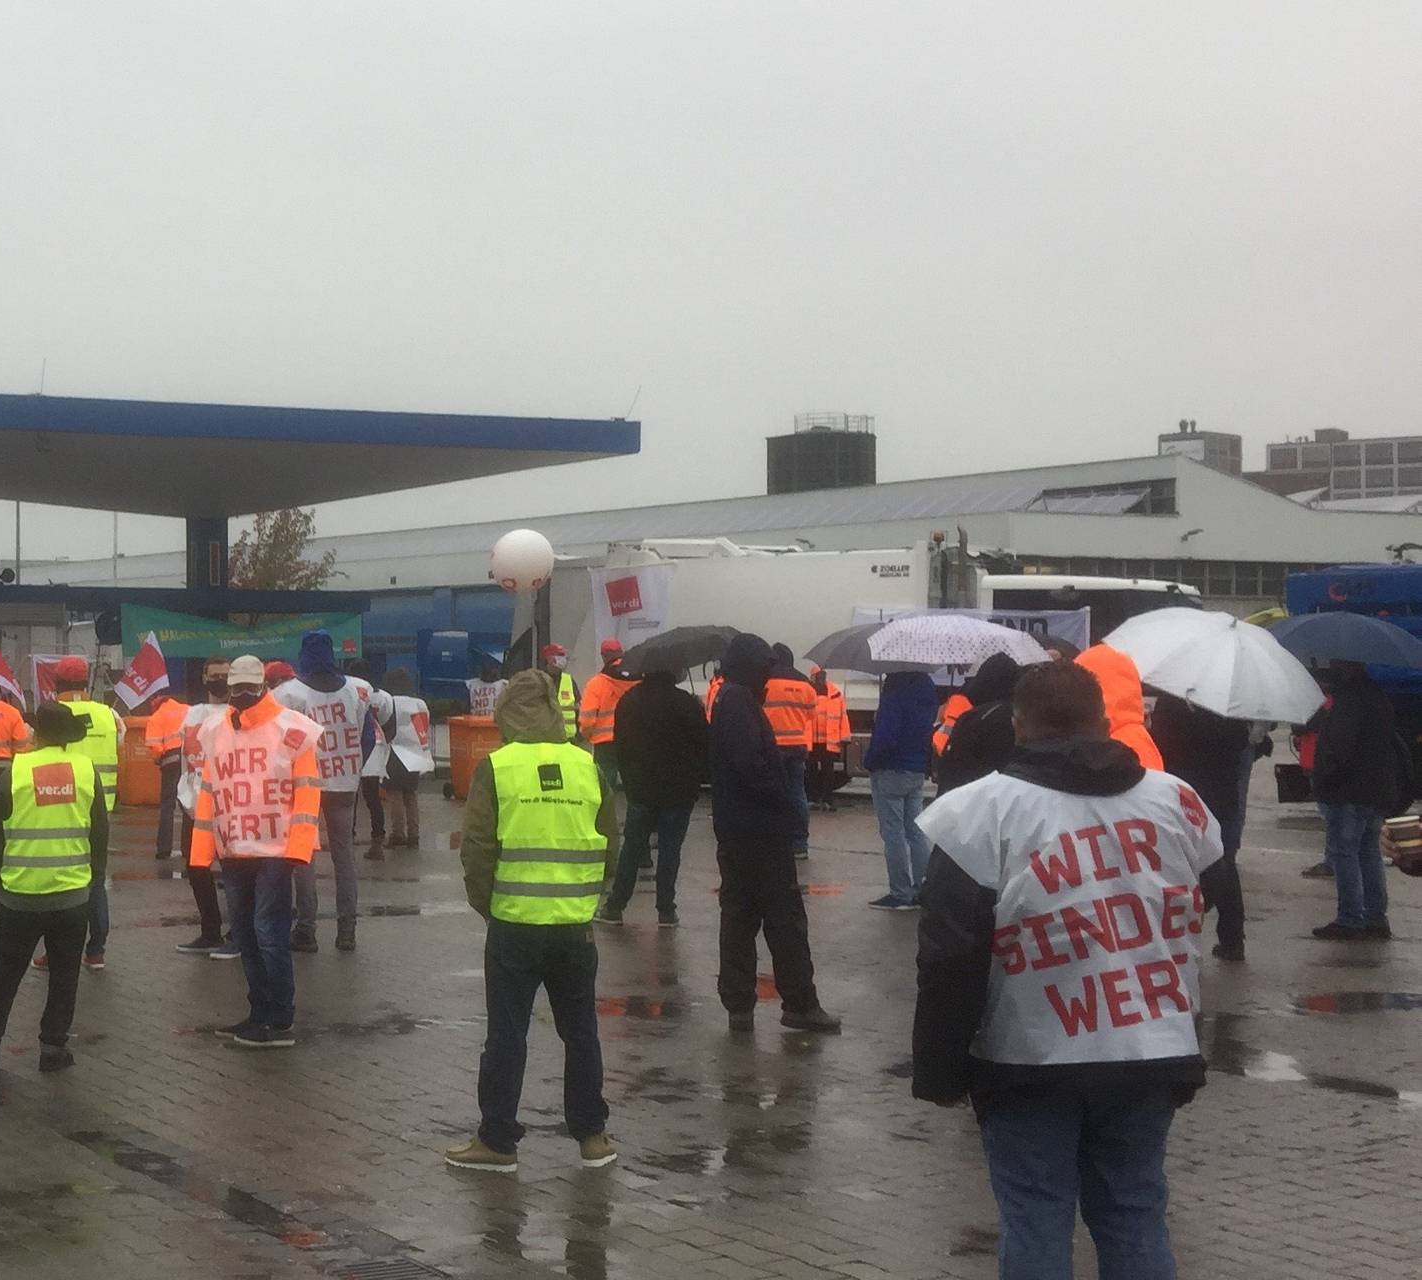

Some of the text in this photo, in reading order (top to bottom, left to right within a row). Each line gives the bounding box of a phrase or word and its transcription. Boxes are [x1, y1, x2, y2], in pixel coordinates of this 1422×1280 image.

[215, 747, 268, 780] WIR
[319, 754, 363, 779] ERT.
[37, 784, 73, 795] ver.di
[212, 781, 251, 817] IND
[1030, 818, 1161, 894] WIR
[992, 893, 1154, 976] SIND
[1044, 953, 1190, 1038] WER
